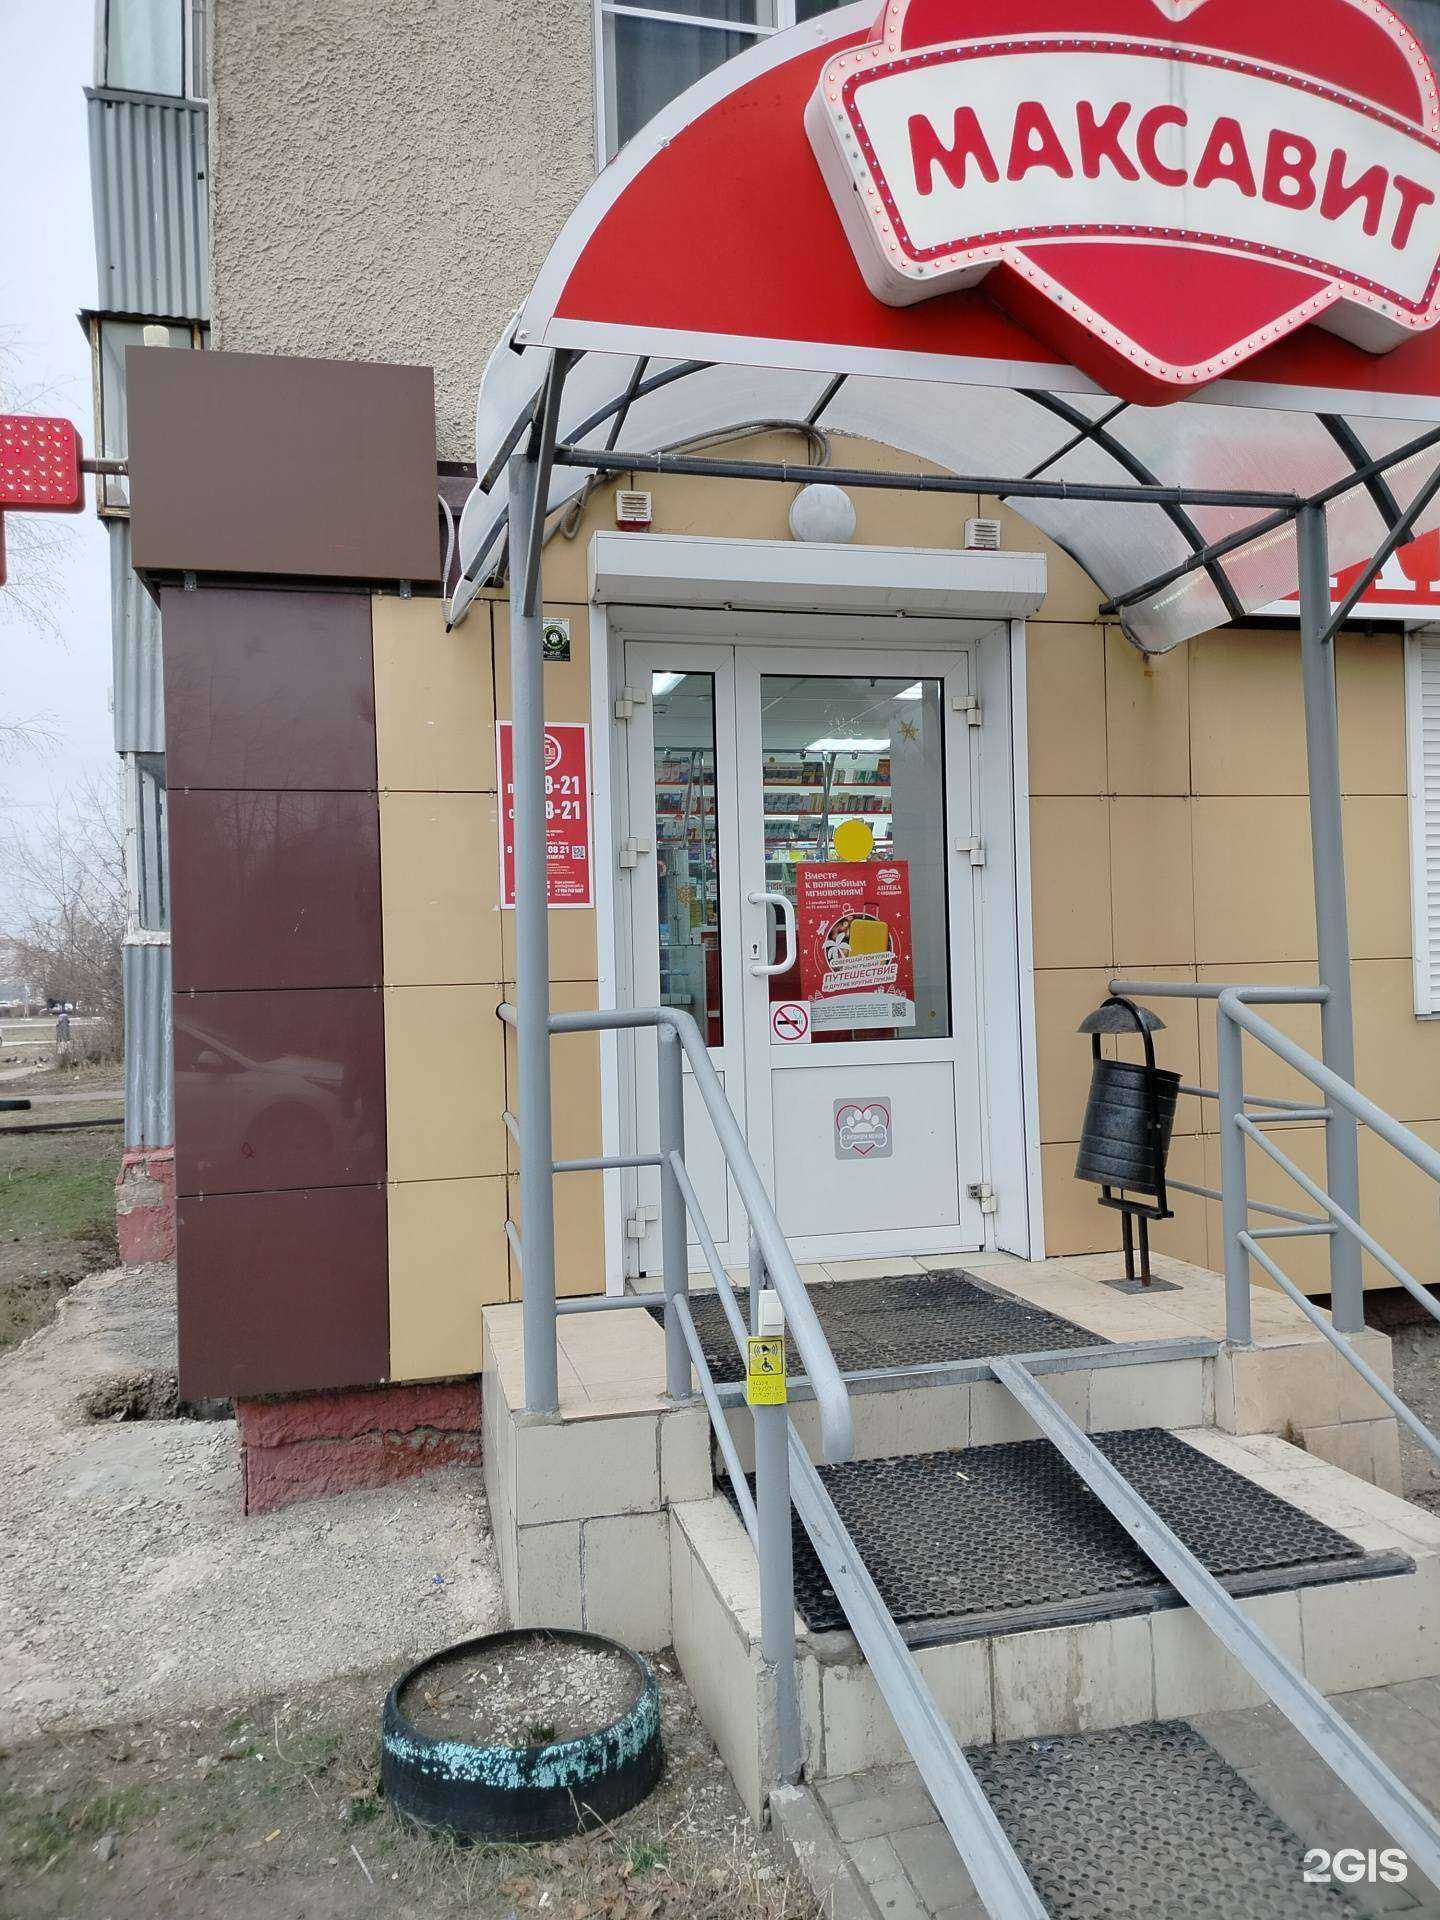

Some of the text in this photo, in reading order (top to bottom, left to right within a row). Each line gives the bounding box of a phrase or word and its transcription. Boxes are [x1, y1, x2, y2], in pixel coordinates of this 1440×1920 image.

[907, 99, 1435, 251] МАКСАВИТ
[805, 872, 837, 880] Вместе
[805, 881, 811, 889] к
[812, 878, 867, 888] волшебным
[805, 886, 864, 897] мгновениям!
[824, 965, 896, 983] ПУТЕШЕСТВИЕ
